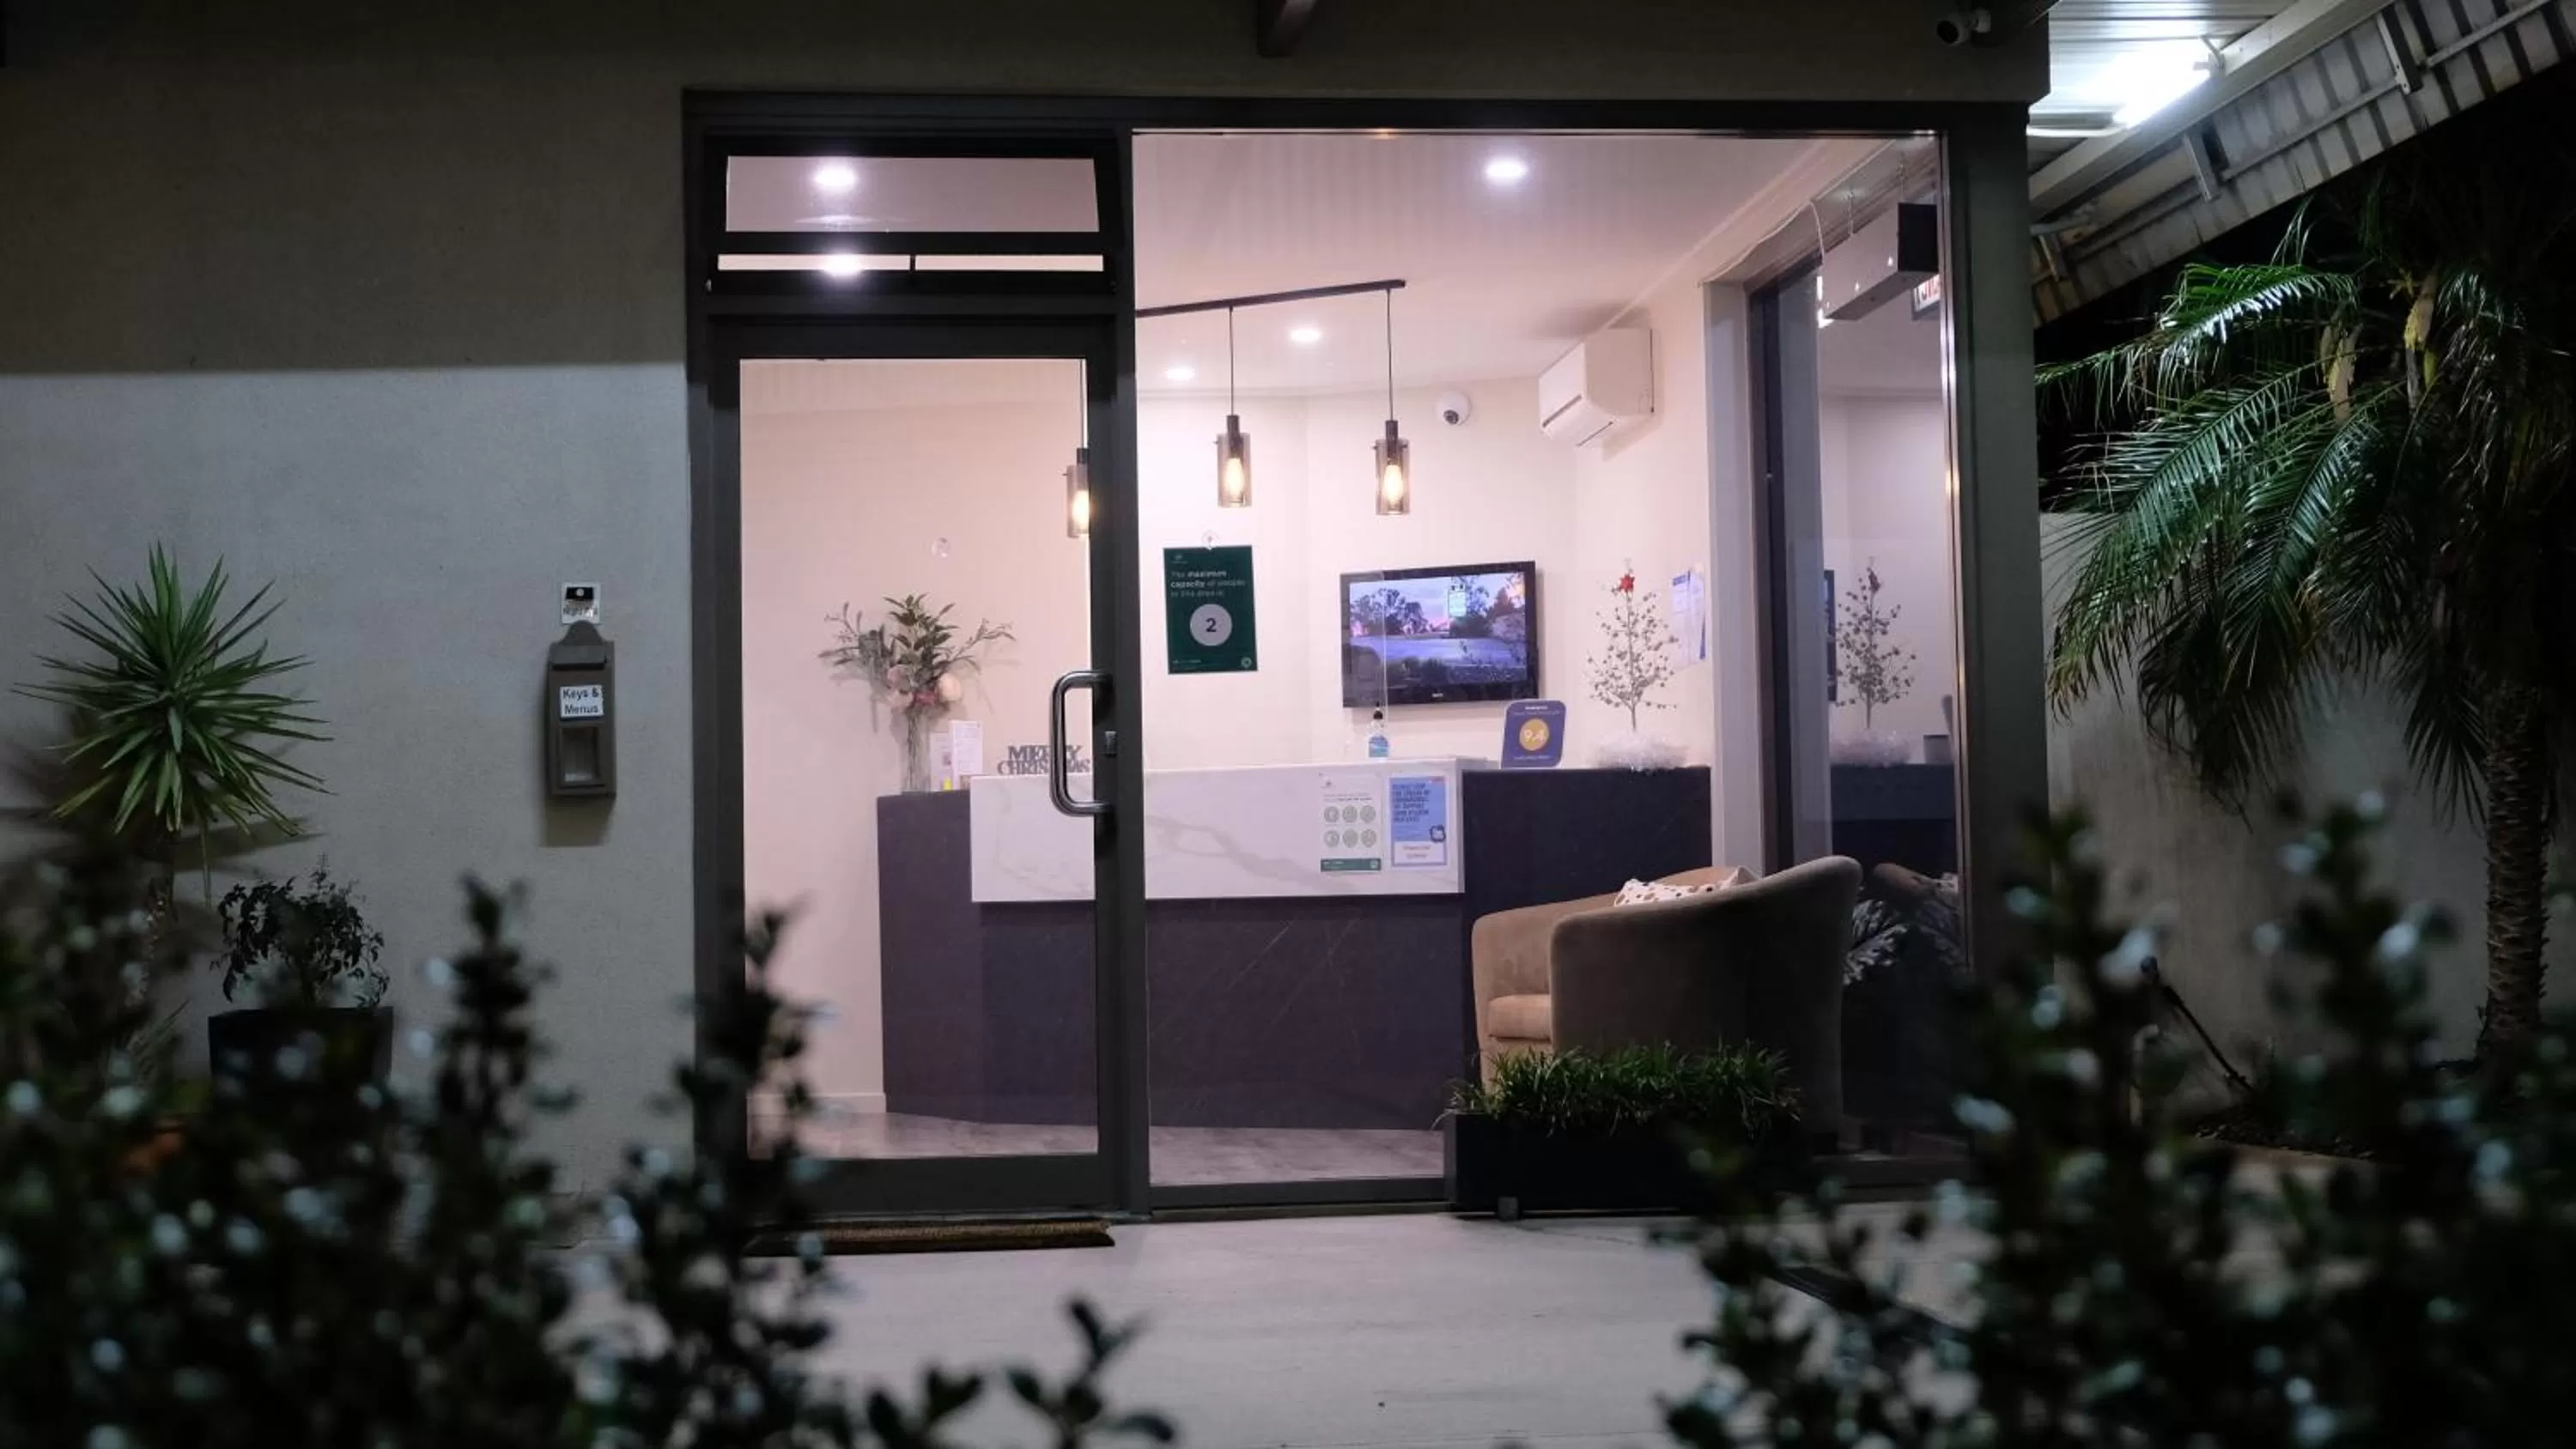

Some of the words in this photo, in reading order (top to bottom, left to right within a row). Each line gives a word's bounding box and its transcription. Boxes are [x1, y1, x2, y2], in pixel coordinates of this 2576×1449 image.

[1170, 580, 1206, 589] capacity
[1206, 618, 1217, 633] 2
[562, 688, 588, 700] Keys
[564, 703, 598, 714] Menus
[1007, 744, 1084, 761] MERY
[996, 760, 1091, 775] CHRISAS
